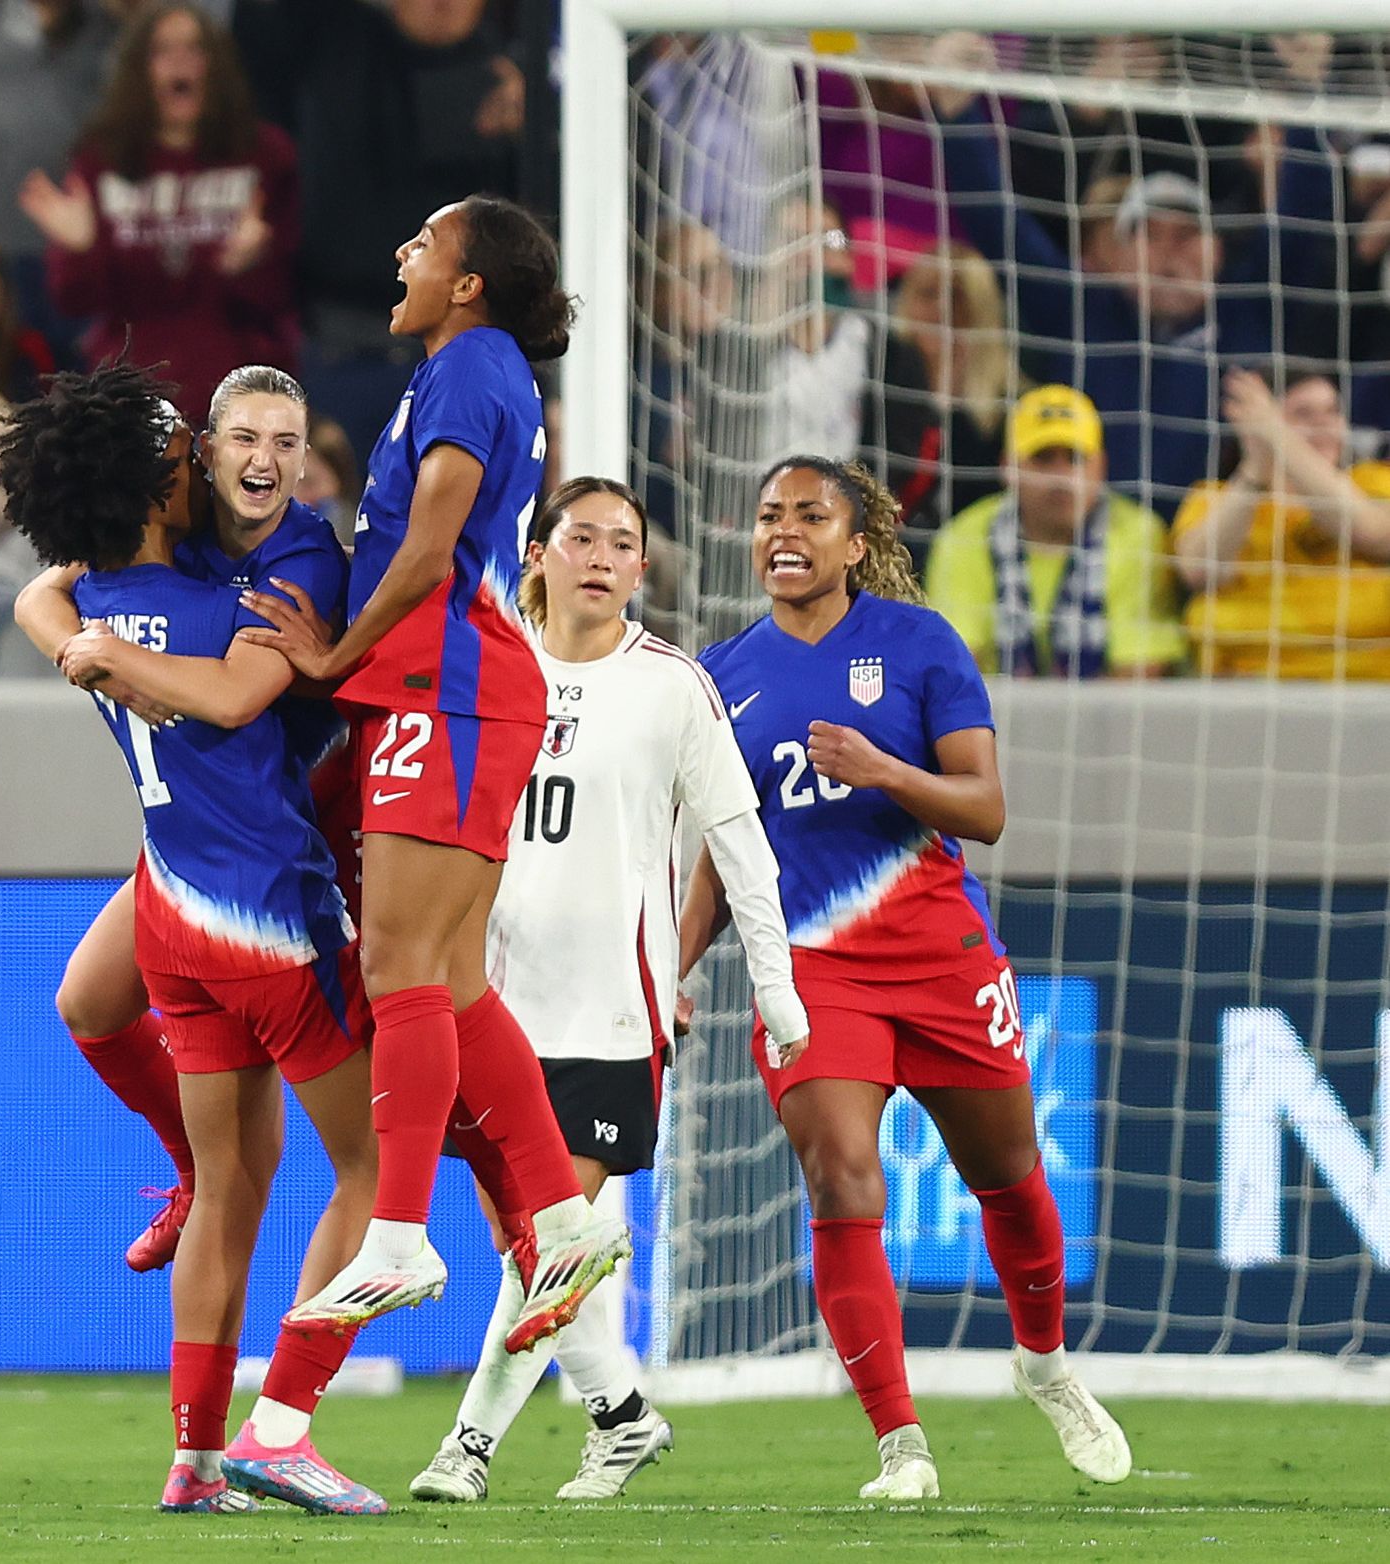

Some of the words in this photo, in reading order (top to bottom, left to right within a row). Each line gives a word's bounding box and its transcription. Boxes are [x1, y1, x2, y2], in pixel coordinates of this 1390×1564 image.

[555, 683, 583, 701] Y-3
[852, 667, 881, 682] USA
[369, 712, 434, 780] 22
[523, 773, 576, 844] 10
[975, 966, 1022, 1049] 20
[593, 1118, 619, 1145] Y-3
[179, 1403, 190, 1444] USA
[457, 1420, 494, 1453] Y-3
